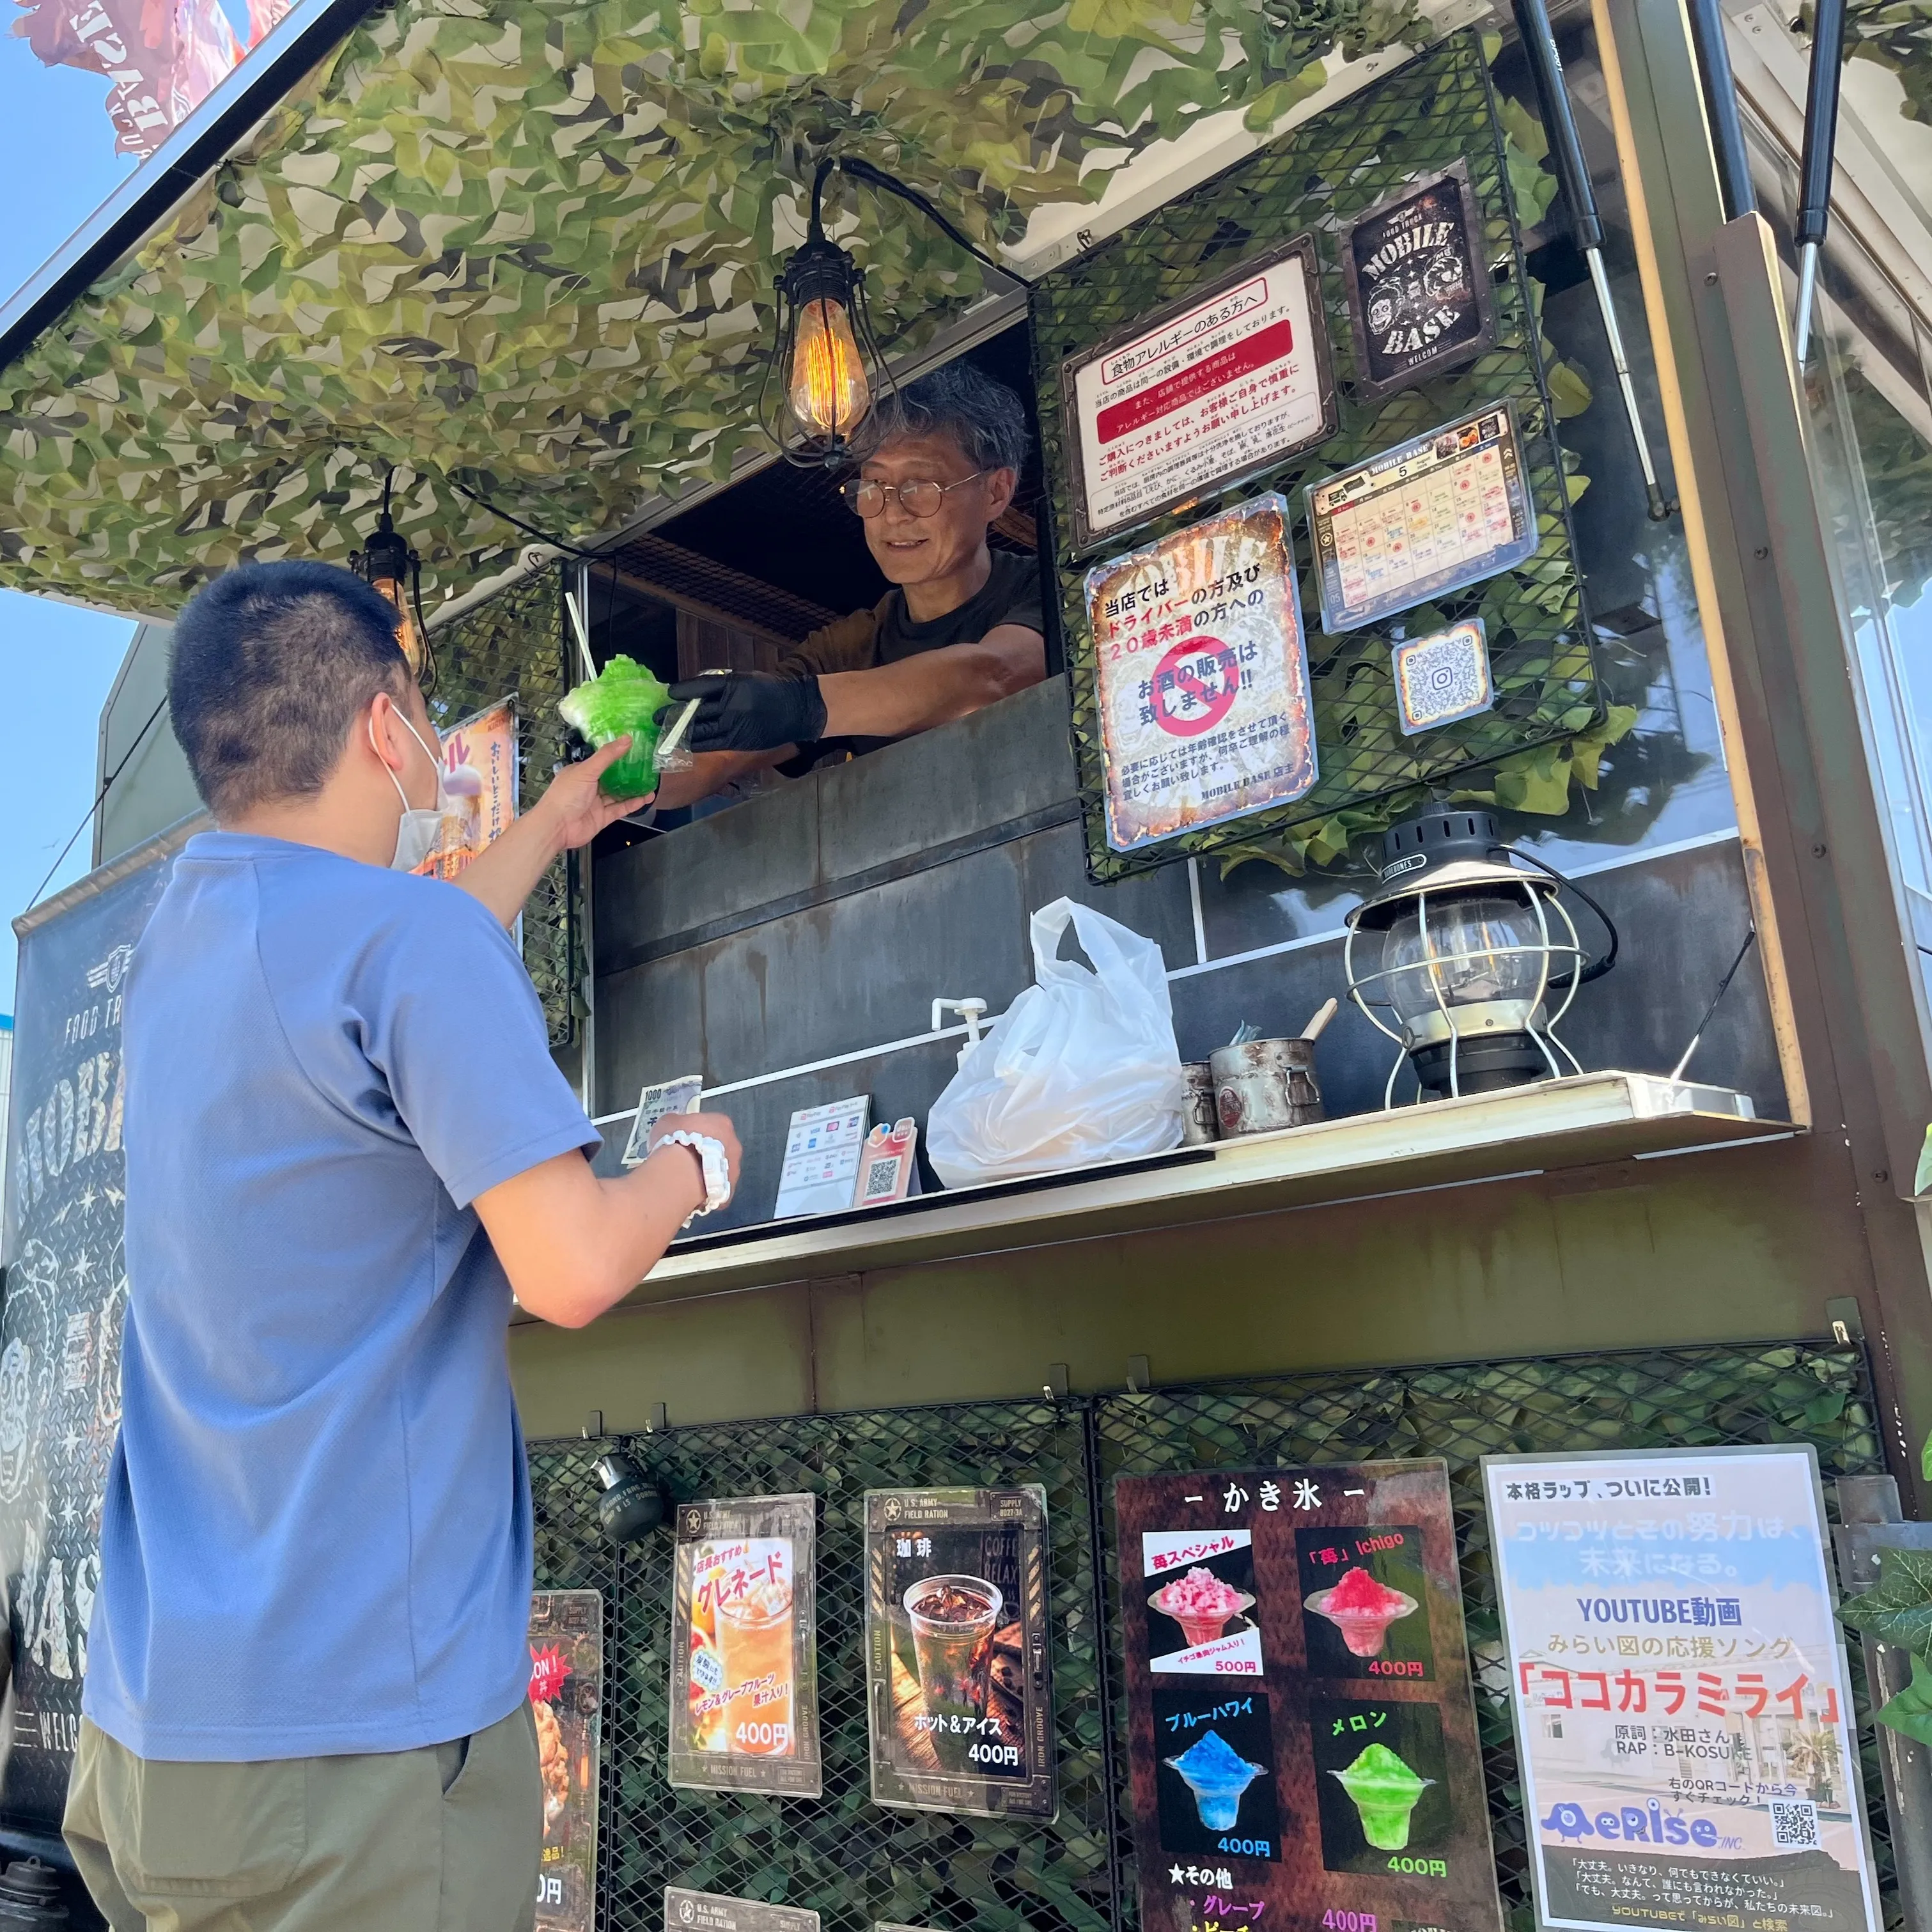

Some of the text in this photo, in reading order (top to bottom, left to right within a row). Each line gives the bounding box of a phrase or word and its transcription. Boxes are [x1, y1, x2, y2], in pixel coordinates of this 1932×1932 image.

[1362, 222, 1454, 281] MOBILE
[1111, 298, 1258, 378] 食物アレルギーのある方へ
[1382, 305, 1461, 355] BASE
[1407, 346, 1438, 366] WELCOM
[1370, 444, 1429, 475] MOBILE BASE
[1399, 465, 1407, 477] 5
[1105, 578, 1170, 618] 当店では
[1108, 563, 1261, 639] ドライバーの方及び
[1138, 640, 1258, 700] お酒の販売は
[1201, 782, 1240, 802] MOBILE
[1243, 772, 1272, 790] BASE
[65, 1005, 98, 1047] FOOD
[645, 1088, 662, 1101] 1000
[1222, 1477, 1323, 1513] かき氷
[1506, 1477, 1711, 1501] 本格ラップ、ついに公開!
[904, 1509, 948, 1519] FIELD RATION
[919, 1498, 938, 1507] ARMY
[1000, 1499, 1022, 1508] SUPPLY
[695, 1545, 742, 1574] 店長おすすめ
[1151, 1536, 1235, 1570] 苺スペシャル
[1355, 1532, 1405, 1564] Ichigo
[697, 1551, 783, 1614] グレネード
[985, 1564, 1018, 1584] RELAX
[1577, 1597, 1742, 1628] YOUTUBE動画
[873, 1629, 882, 1673] CAUTION
[1547, 1633, 1794, 1659] みらい図の応援ソング
[530, 1655, 557, 1682] ON!
[1215, 1660, 1257, 1673] 500円
[1368, 1660, 1425, 1678] 400円
[1519, 1663, 1839, 1724] 「ココカラミライ」
[801, 1704, 810, 1738] GROOVE
[914, 1713, 1003, 1736] ホット&アイス
[1036, 1706, 1045, 1743] GROOVE
[1165, 1696, 1254, 1733] ブルーハワイ
[1332, 1711, 1388, 1736] メロン
[736, 1721, 788, 1747] 400円
[968, 1743, 1018, 1766] 400円
[710, 1764, 757, 1777] MISSION FUEL
[908, 1782, 942, 1796] MISSION
[1668, 1777, 1798, 1797] 右のQRコードから今
[1217, 1836, 1271, 1858] 400円
[1387, 1856, 1447, 1878] 400円
[697, 1915, 736, 1931] FIELD RATION
[710, 1906, 728, 1918] ARMY
[779, 1920, 801, 1930] SUPPLY
[1321, 1908, 1377, 1932] 400円
